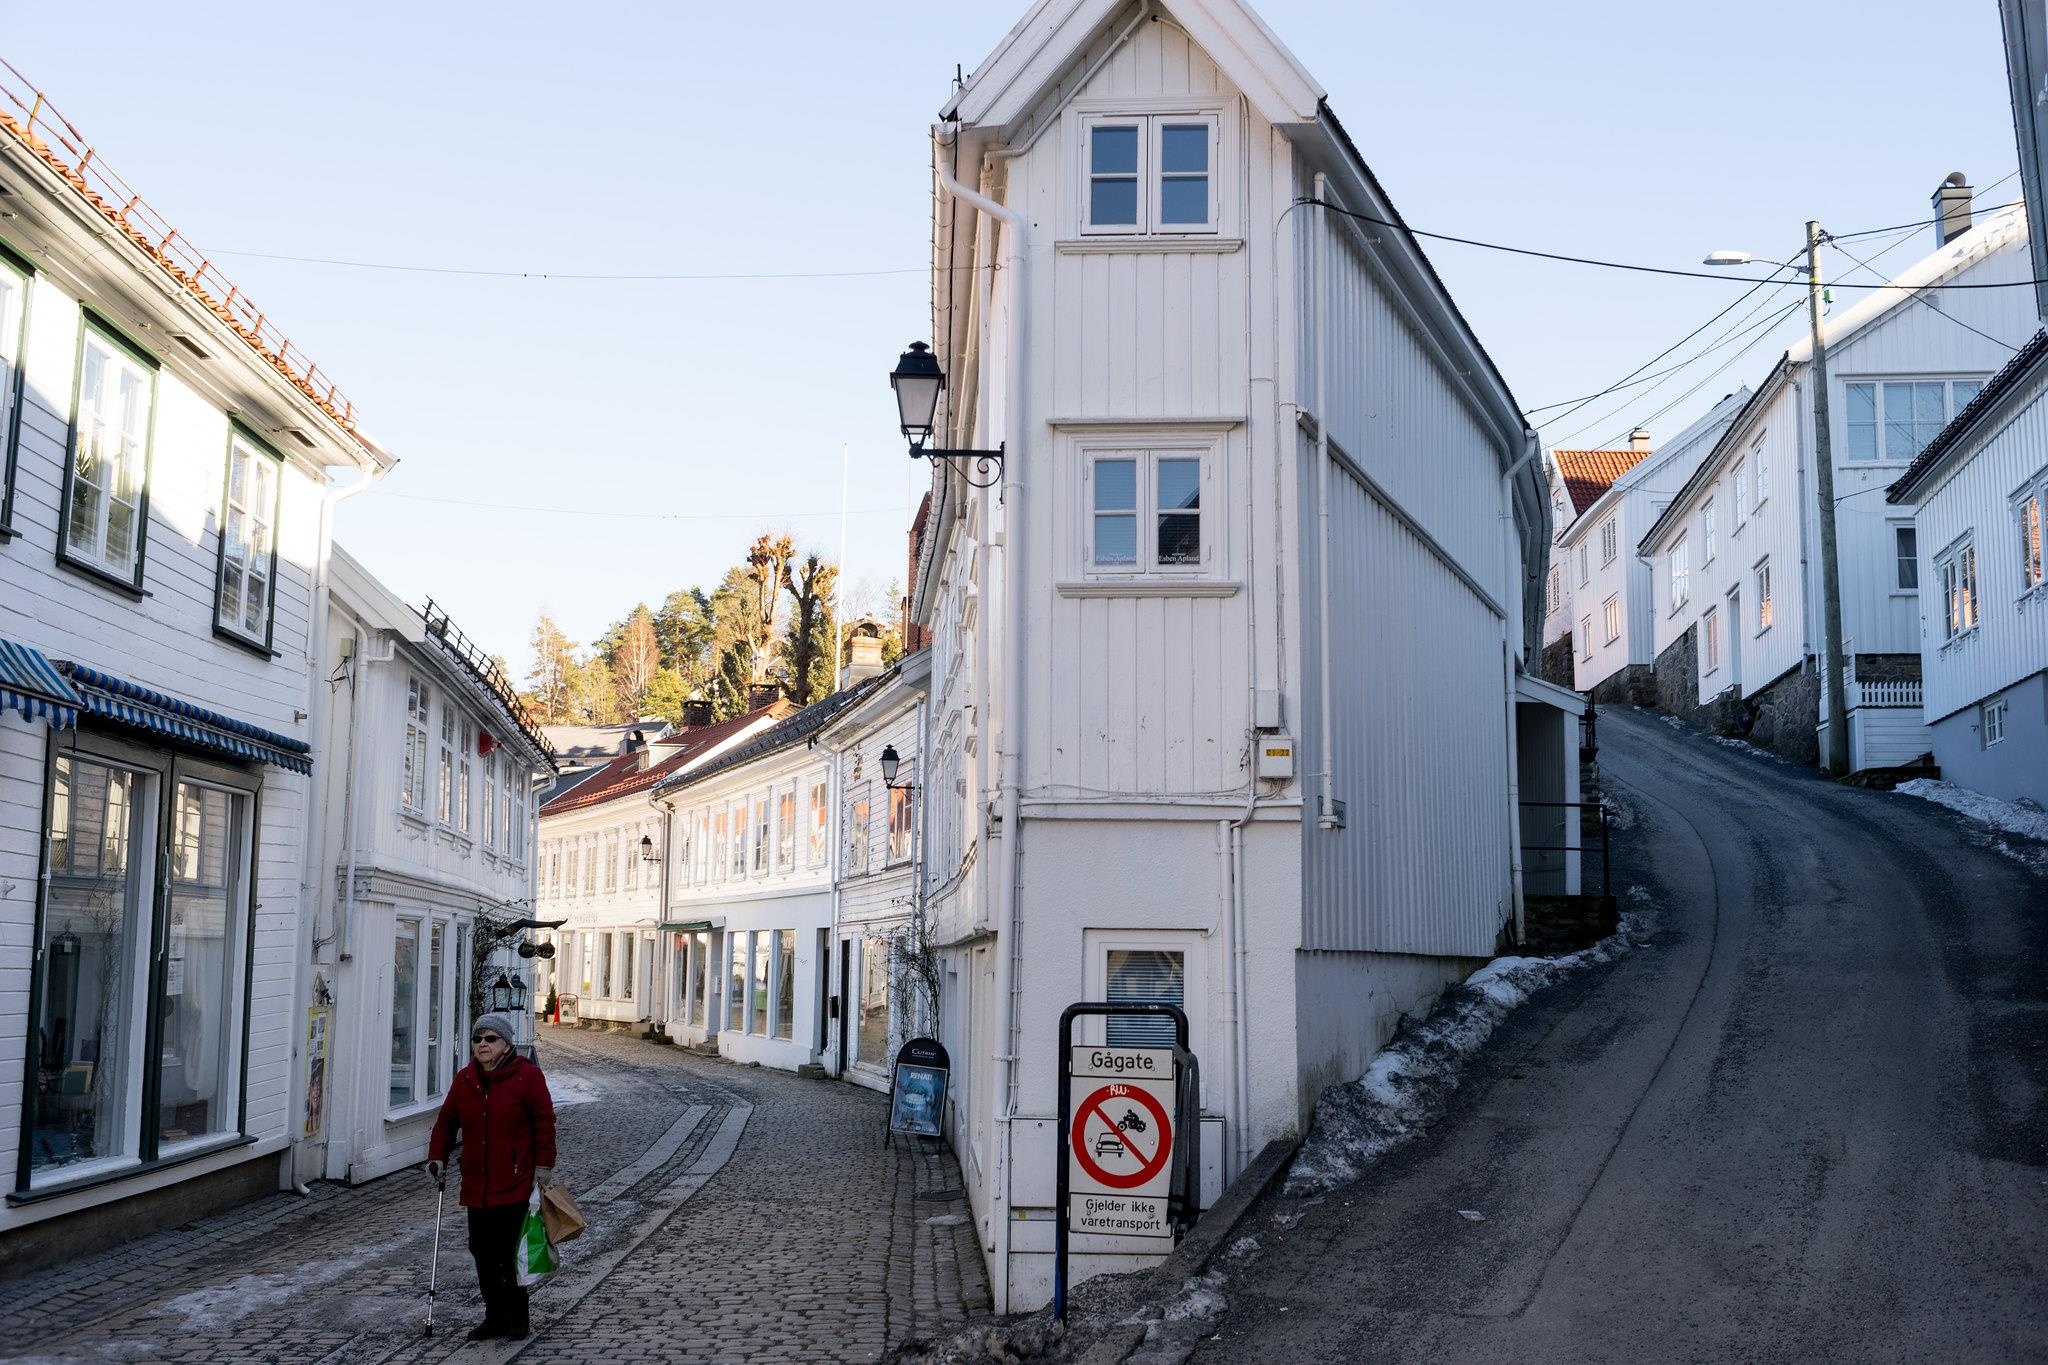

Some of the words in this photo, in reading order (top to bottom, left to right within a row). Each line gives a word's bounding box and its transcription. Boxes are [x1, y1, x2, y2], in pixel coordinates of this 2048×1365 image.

[1091, 1051, 1153, 1073] Gågate
[1085, 1198, 1126, 1213] Gjelder
[1131, 1200, 1155, 1213] ikke
[1080, 1216, 1160, 1231] varetransport
